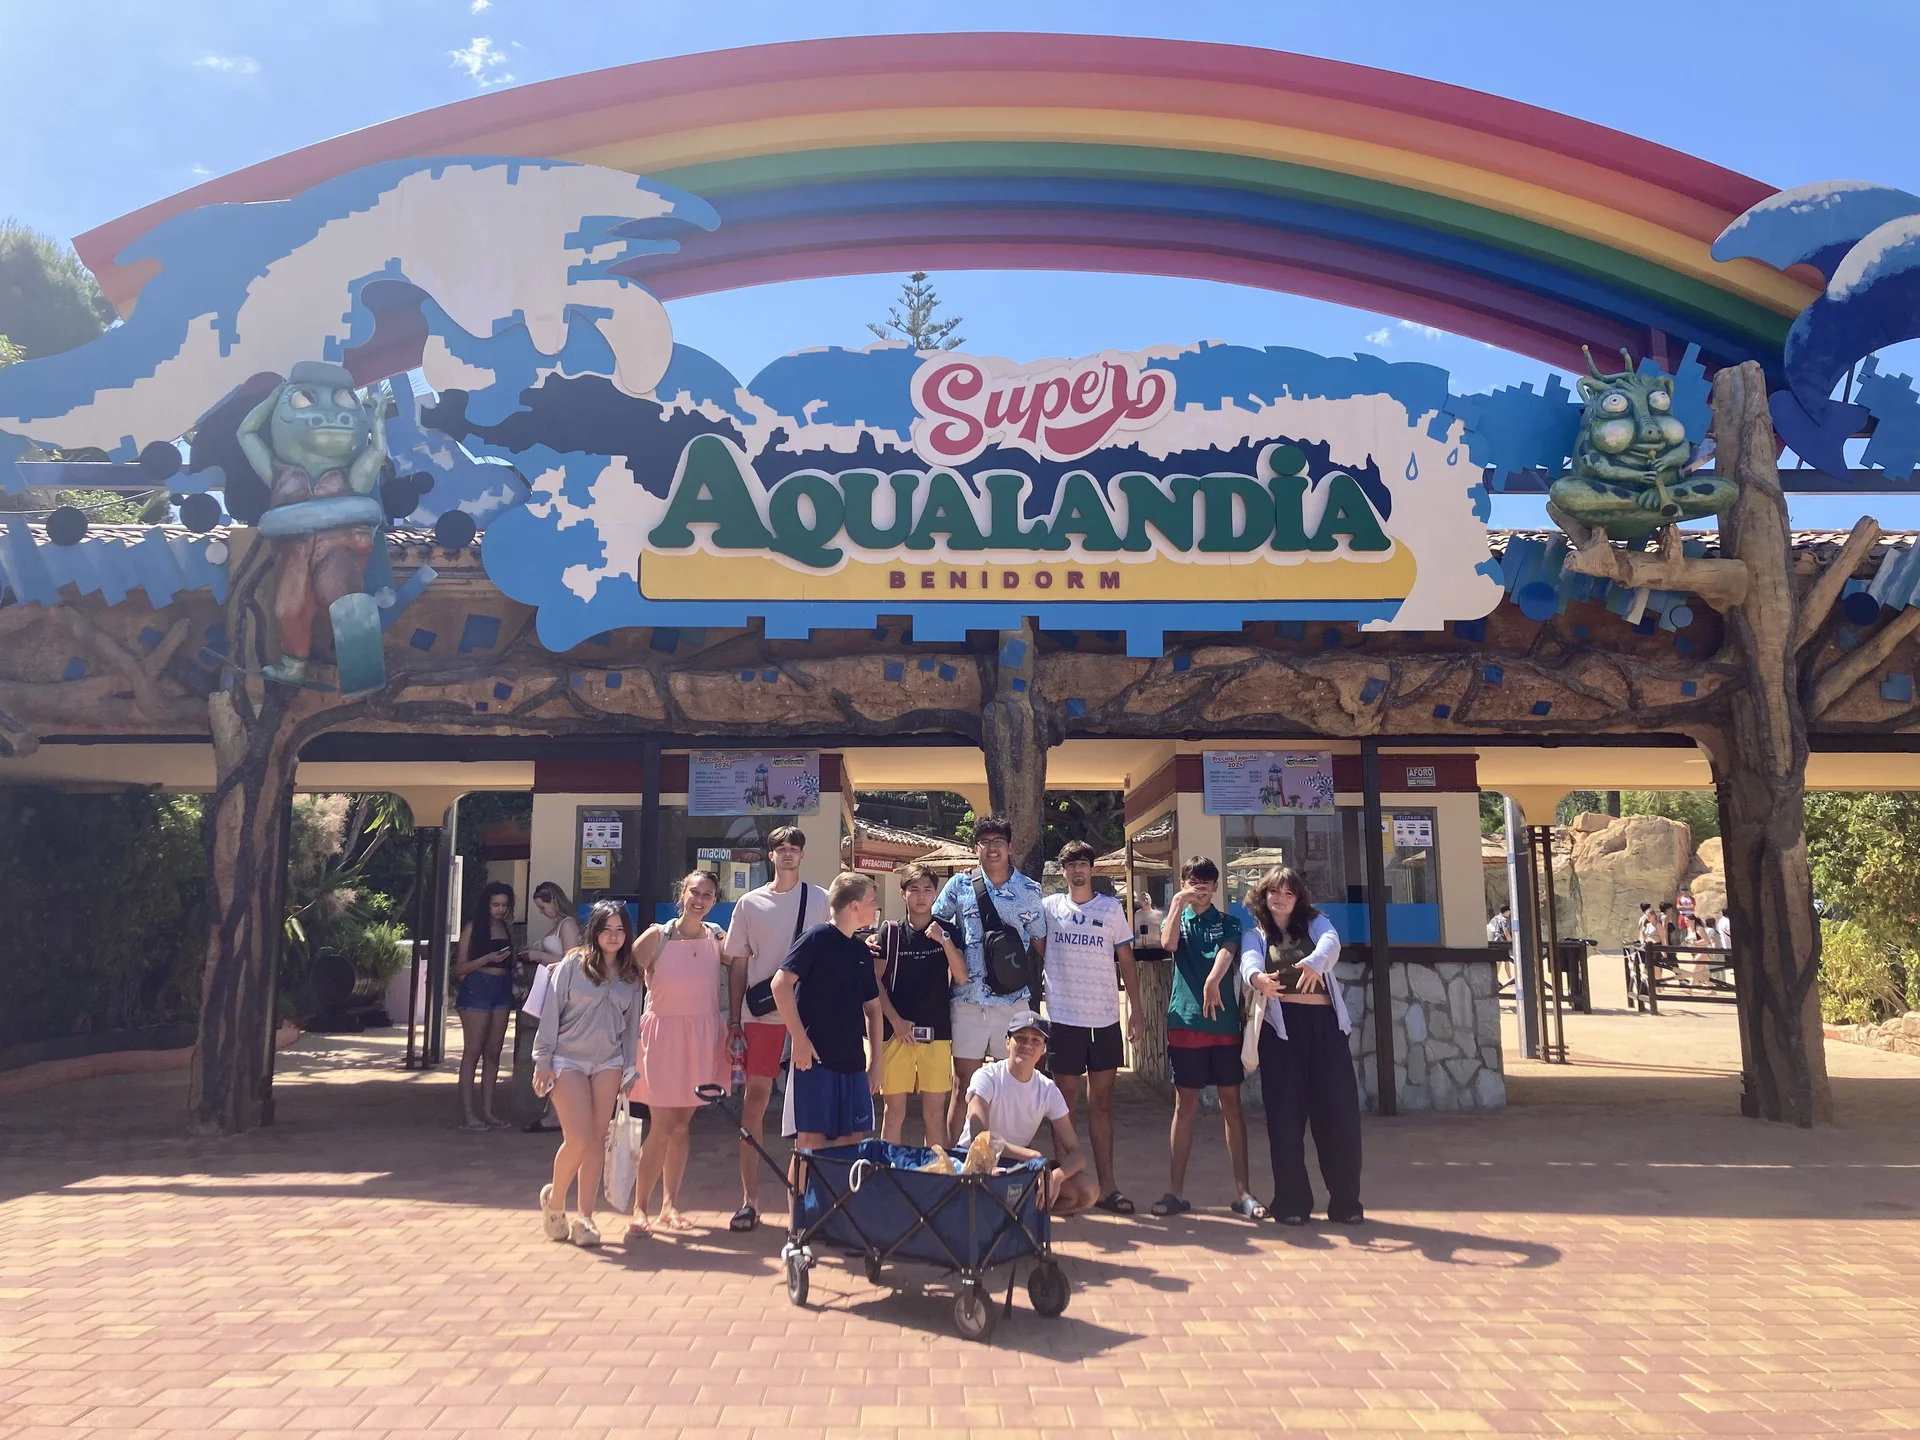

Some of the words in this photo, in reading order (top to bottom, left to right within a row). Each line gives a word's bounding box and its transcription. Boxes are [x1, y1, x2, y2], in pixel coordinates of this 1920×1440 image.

[922, 361, 1166, 456] Super
[889, 570, 1122, 589] BENIDORM
[1234, 754, 1258, 762] Taquilla
[1409, 768, 1433, 777] AFORO
[861, 858, 894, 869] OPERACIONES
[1054, 931, 1104, 948] ZANZIBAR
